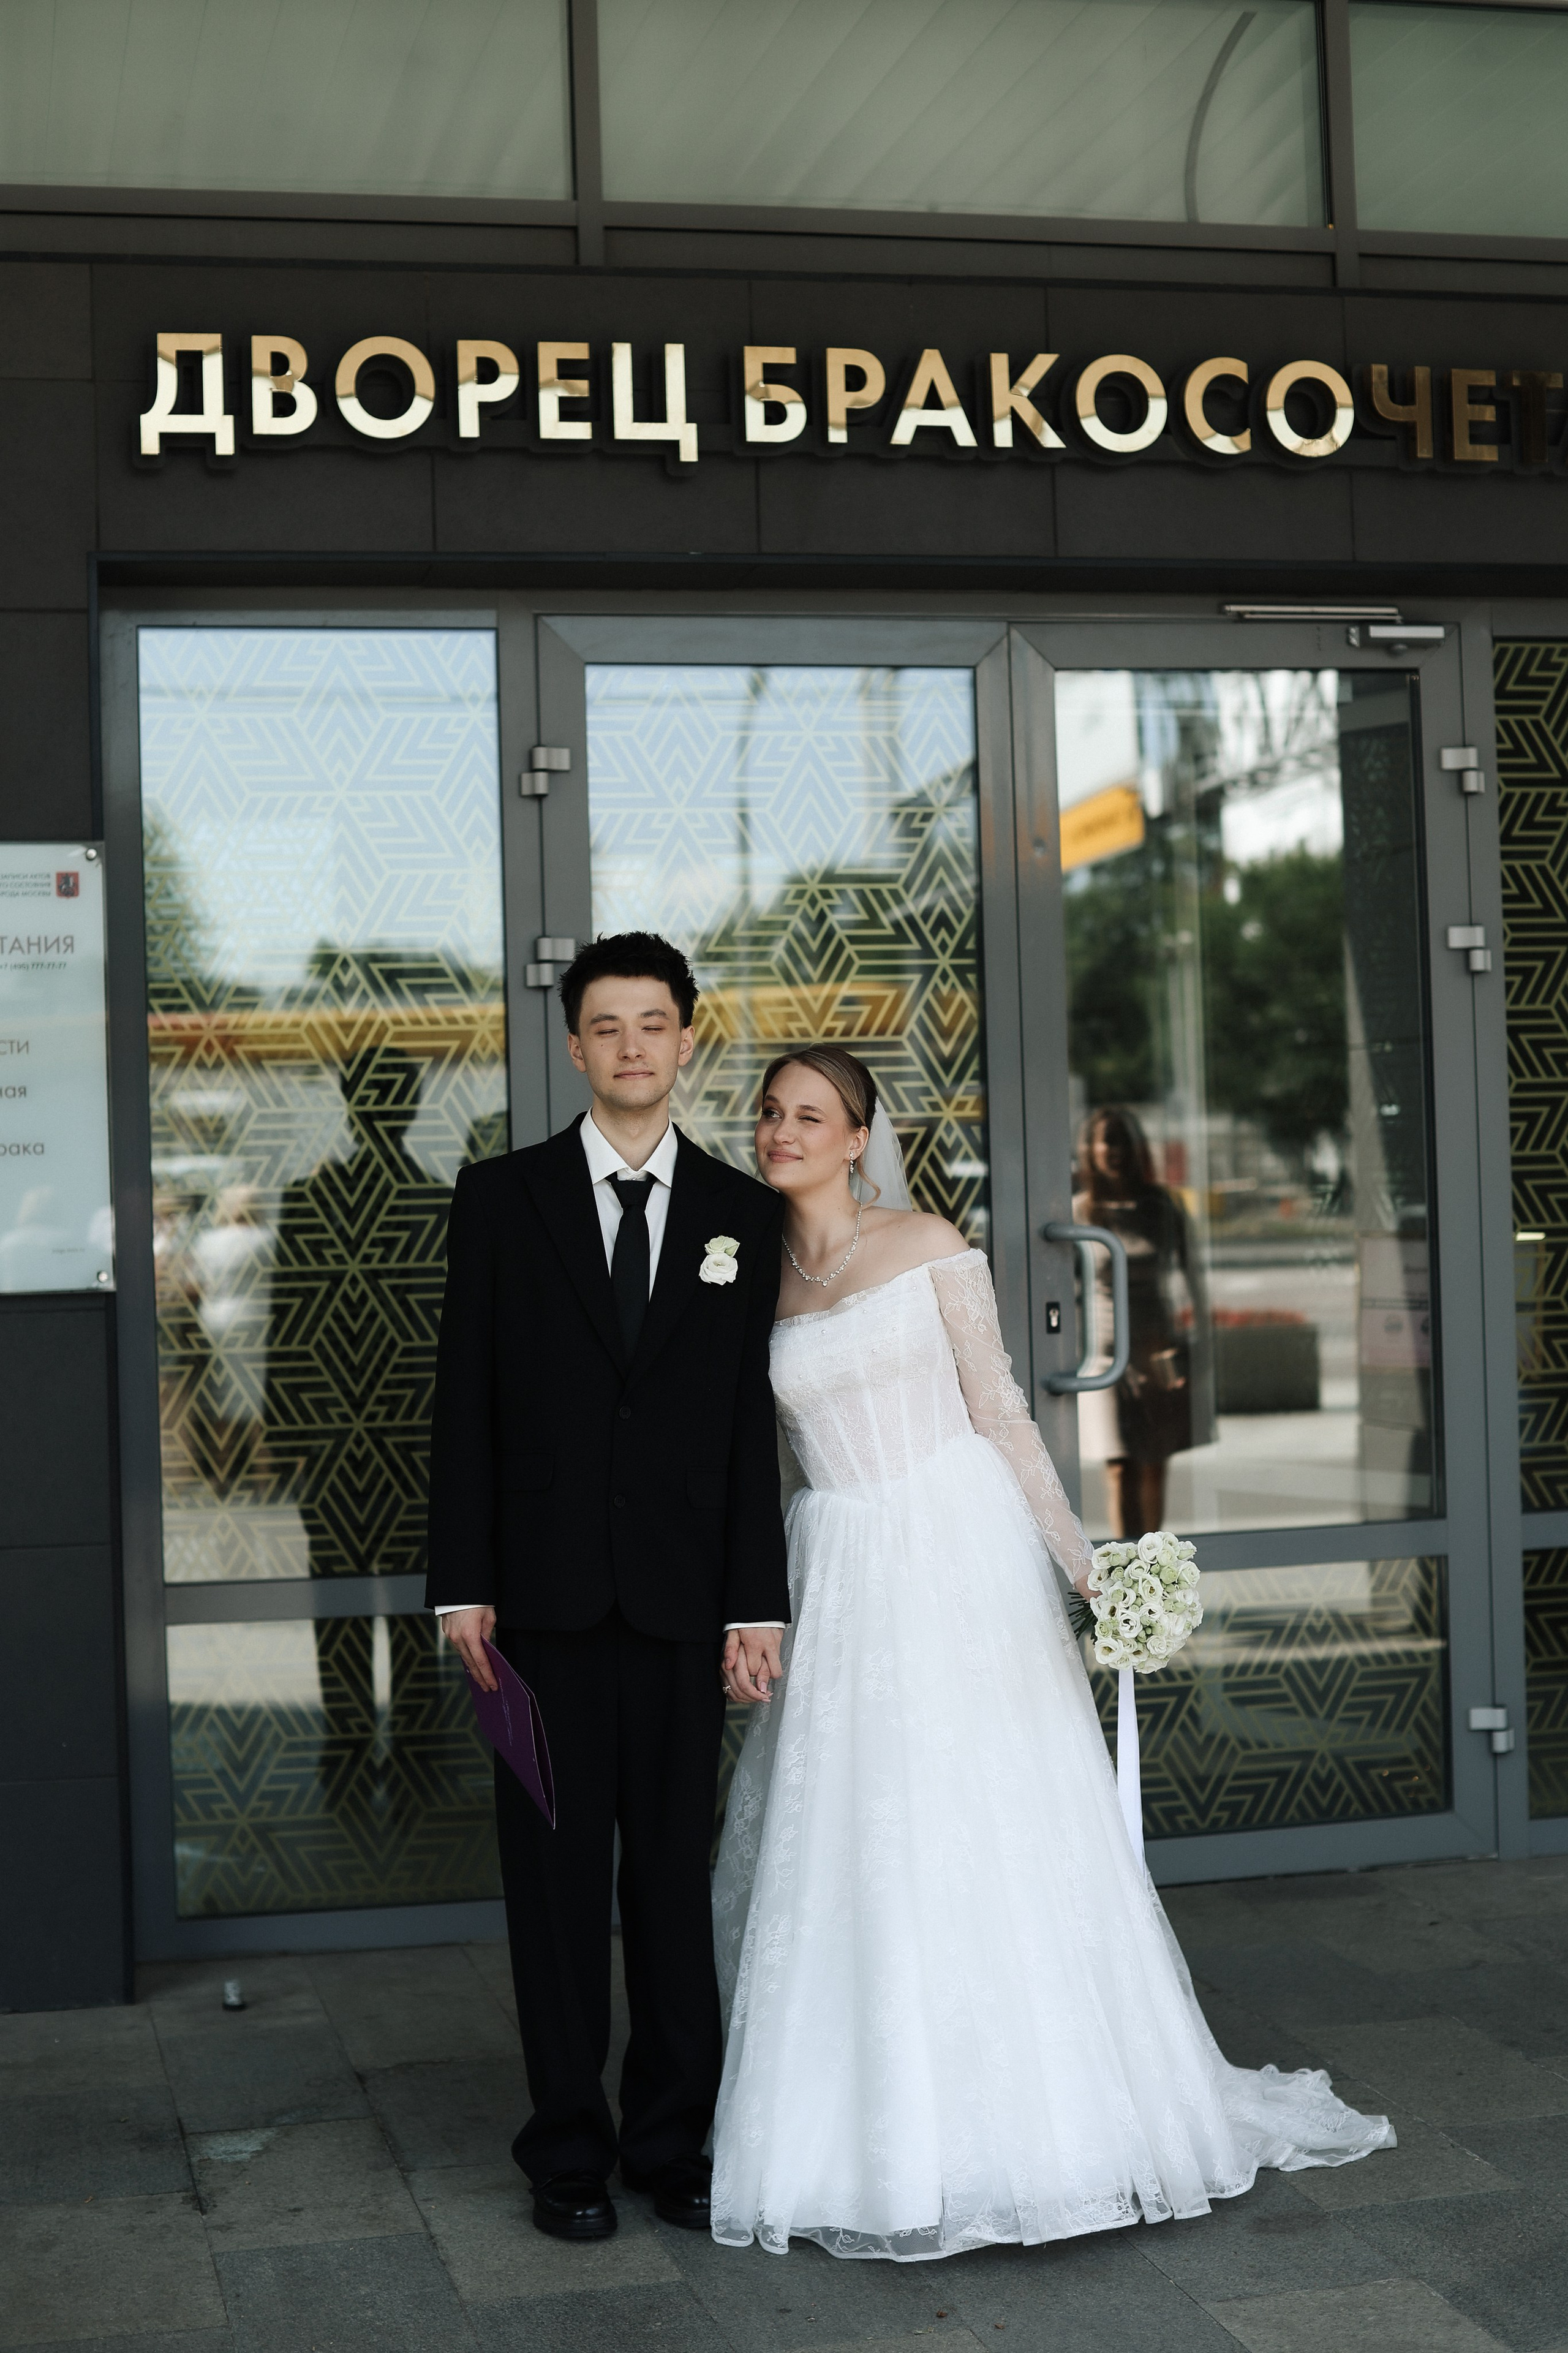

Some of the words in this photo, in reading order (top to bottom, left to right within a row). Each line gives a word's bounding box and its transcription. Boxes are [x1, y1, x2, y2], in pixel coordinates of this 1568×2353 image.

[139, 332, 698, 463] ДВОРЕЦ
[743, 346, 1568, 463] БРАКОСОЧЕТ
[0, 935, 74, 954] ТАНИЯ
[0, 1085, 27, 1099] ая
